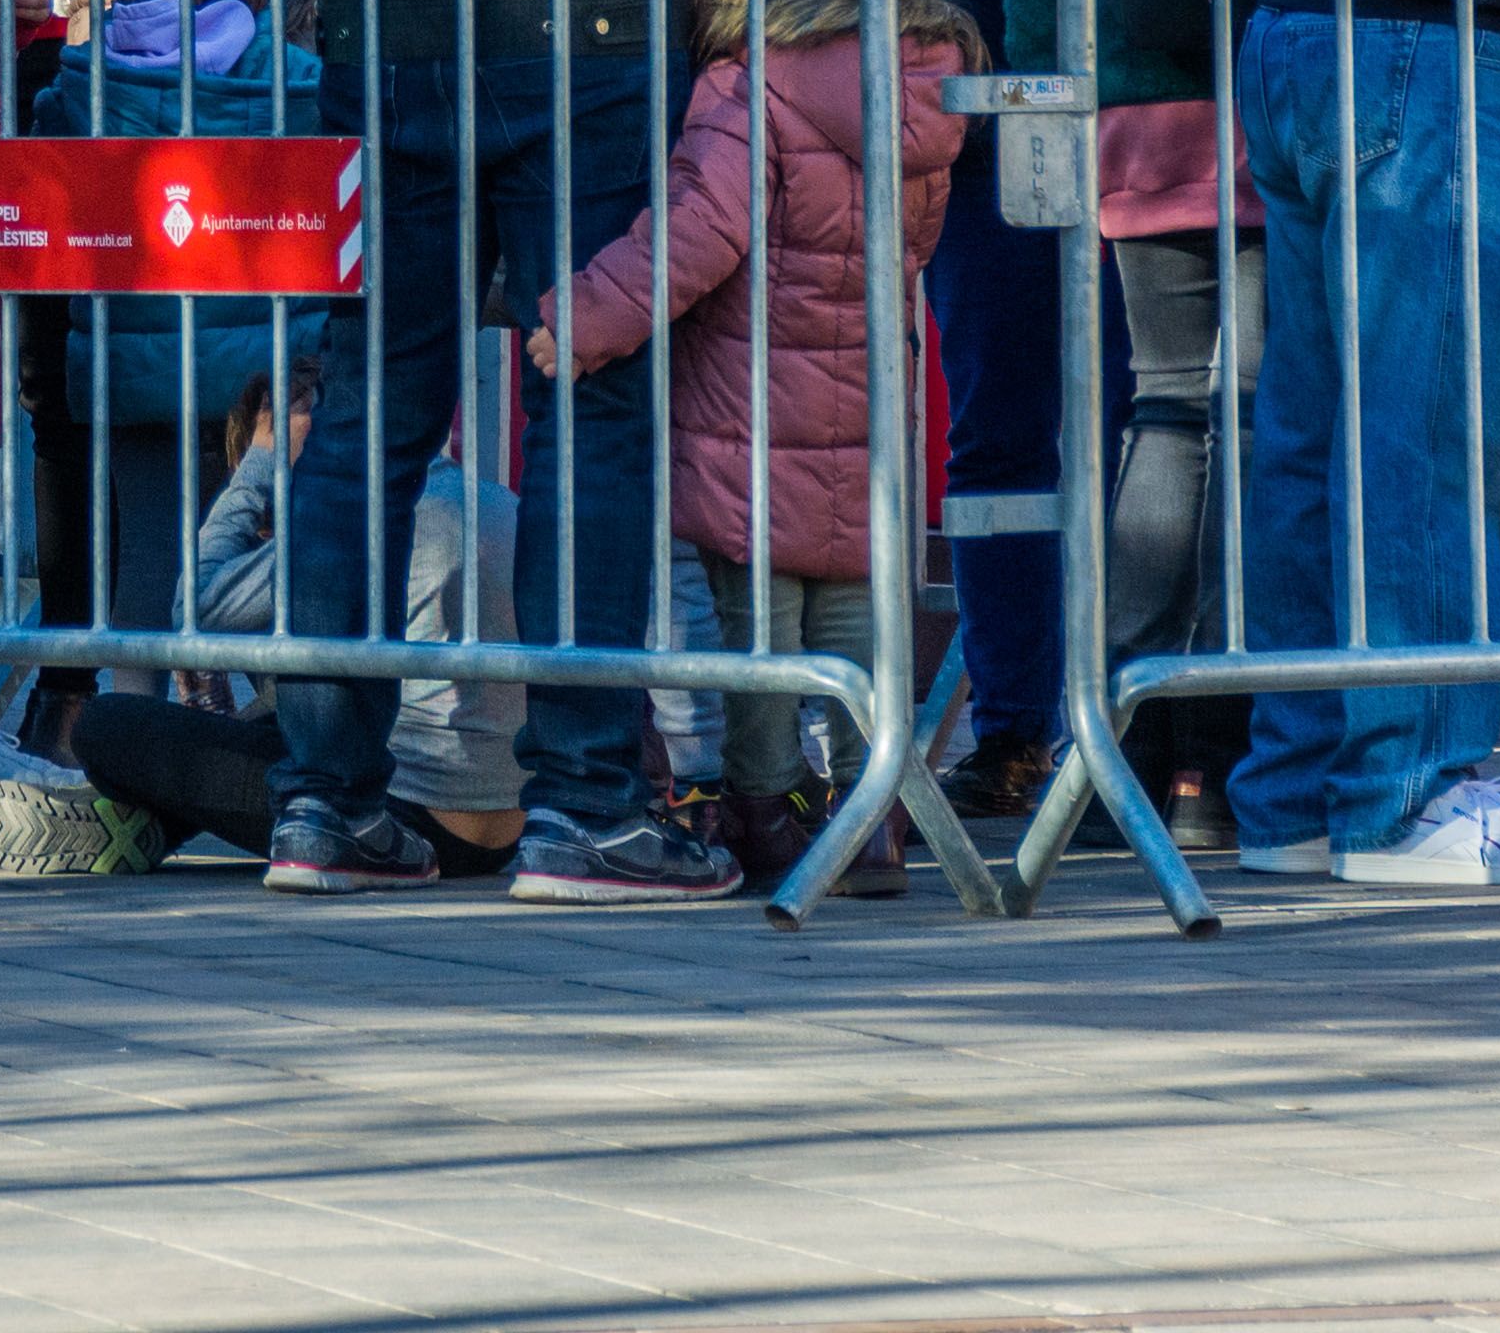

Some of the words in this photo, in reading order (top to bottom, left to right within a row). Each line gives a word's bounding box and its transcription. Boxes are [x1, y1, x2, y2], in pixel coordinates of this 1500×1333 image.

[200, 213, 275, 235] Ajuntament
[277, 213, 294, 230] de
[297, 213, 326, 231] Rubí
[67, 233, 133, 247] www.rubi.cat
